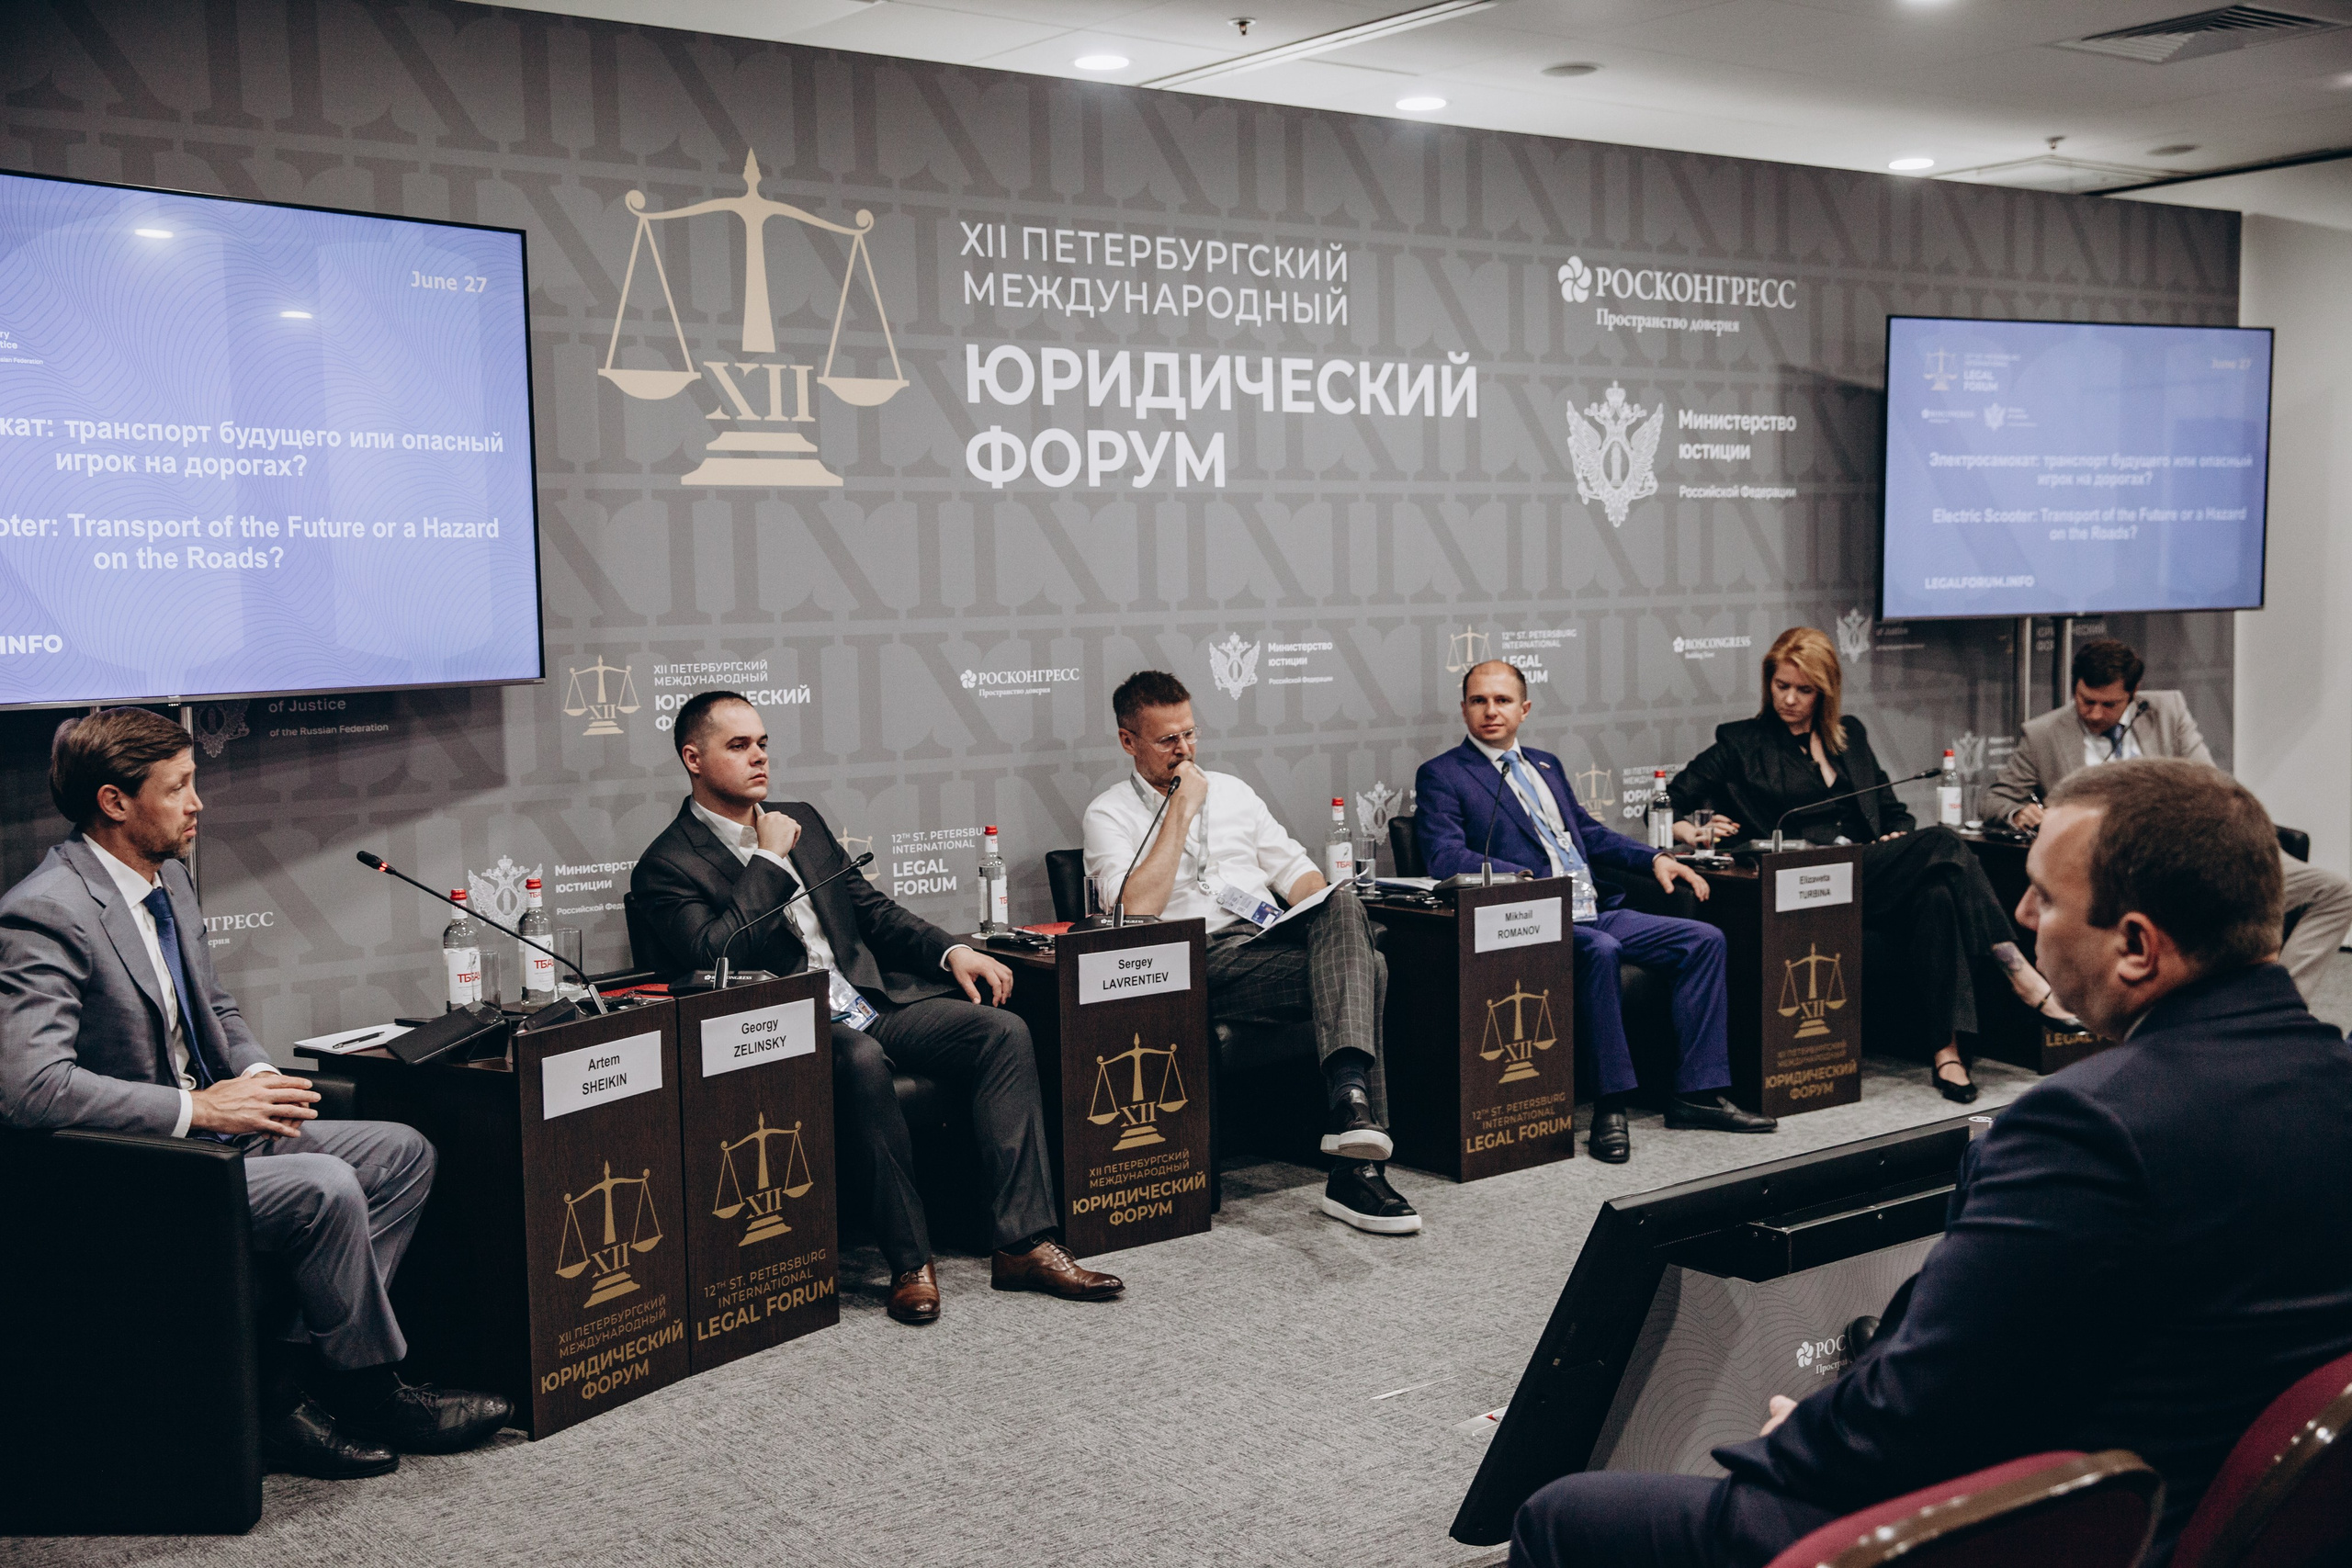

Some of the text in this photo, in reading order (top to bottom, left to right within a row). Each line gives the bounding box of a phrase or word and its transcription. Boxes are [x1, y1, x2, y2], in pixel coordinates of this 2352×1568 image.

[960, 222, 1349, 283] XII ПЕТЕРБУРГСКИЙ
[410, 270, 488, 294] June 27
[1595, 266, 1797, 309] РОСКОНГРЕСС
[964, 271, 1349, 326] МЕЖДУНАРОДНЫЙ
[1596, 308, 1740, 337] Пространство доверия
[966, 343, 1477, 420] ЮРИДИЧЕСКИЙ
[1679, 409, 1797, 434] Министерство
[64, 420, 210, 448] транспорт
[220, 421, 342, 450] будущего
[350, 432, 394, 449] или
[401, 431, 503, 453] опасный
[966, 425, 1226, 490] ФОРУМ
[1679, 444, 1751, 462] юстиции
[56, 453, 308, 480] игрок на дорогах?
[1679, 484, 1797, 500] Российской Федерации
[1932, 508, 1983, 524] Electric
[2040, 507, 2100, 525] Transport
[2101, 507, 2116, 522] of
[2117, 507, 2137, 522] the
[2139, 506, 2177, 522] Future
[2180, 510, 2194, 521] or
[2205, 506, 2247, 521] Hazard
[67, 513, 202, 543] Transport
[208, 515, 234, 537] of
[240, 515, 280, 537] the
[288, 515, 366, 538] Future
[372, 520, 396, 538] or
[403, 520, 416, 537] a
[423, 517, 499, 538] Hazard
[2049, 525, 2139, 540] on the Roads?
[93, 546, 284, 570] on the Roads?
[1925, 575, 2035, 590] LEGALFORUM.INFO
[1268, 642, 1333, 653] Министерство
[653, 660, 768, 675] XII ПЕТЕРБУРГСКИЙ
[1268, 657, 1307, 667] юстиции
[654, 671, 768, 686] МЕЖДУНАРОДНЫЙ
[978, 668, 1080, 685] РОСКОНГРЕСС
[978, 689, 1024, 698] Пространство
[268, 698, 346, 713] of Justice
[269, 723, 390, 737] of the Russian Federation
[892, 839, 976, 854] INTERNATIONAL
[912, 832, 927, 842] ST.
[893, 858, 949, 877] LEGAL
[555, 880, 613, 894] юстиции
[893, 876, 957, 897] FORUM
[556, 903, 604, 915] Российской
[1505, 909, 1532, 921] Mikhail
[1498, 925, 1541, 940] ROMANOV
[1118, 957, 1154, 970] Sergey
[1102, 972, 1170, 990] LAVRENTIEV
[741, 1019, 779, 1034] Georgy
[733, 1035, 787, 1058] ZELINSKY
[587, 1055, 620, 1071] Artem
[582, 1073, 628, 1095] SHEIKIN
[1490, 1106, 1504, 1117] ST.
[1506, 1091, 1566, 1113] PETERSBURG
[1482, 1106, 1555, 1130] INTERNATIONAL
[1466, 1114, 1572, 1154] LEGAL FORUM
[1089, 1147, 1190, 1178] XII ПЕТЕРБУРГСКИЙ
[1090, 1159, 1190, 1189] МЕЖДУНАРОДНЫЙ
[1072, 1170, 1206, 1215] ЮРИДИЧЕСКИЙ
[1109, 1200, 1172, 1226] ФОРУМ
[729, 1274, 746, 1291] ST.
[750, 1248, 827, 1284] PETERSBURG
[718, 1268, 814, 1309] INTERNATIONAL
[559, 1293, 666, 1345] XII ПЕТЕРБУРГСКИЙ
[696, 1276, 835, 1341] LEGAL FORUM
[559, 1307, 667, 1359] МЕЖДУНАРОДНЫЙ
[541, 1317, 684, 1394] ЮРИДИЧЕСКИЙ
[582, 1359, 650, 1401] ФОРУМ
